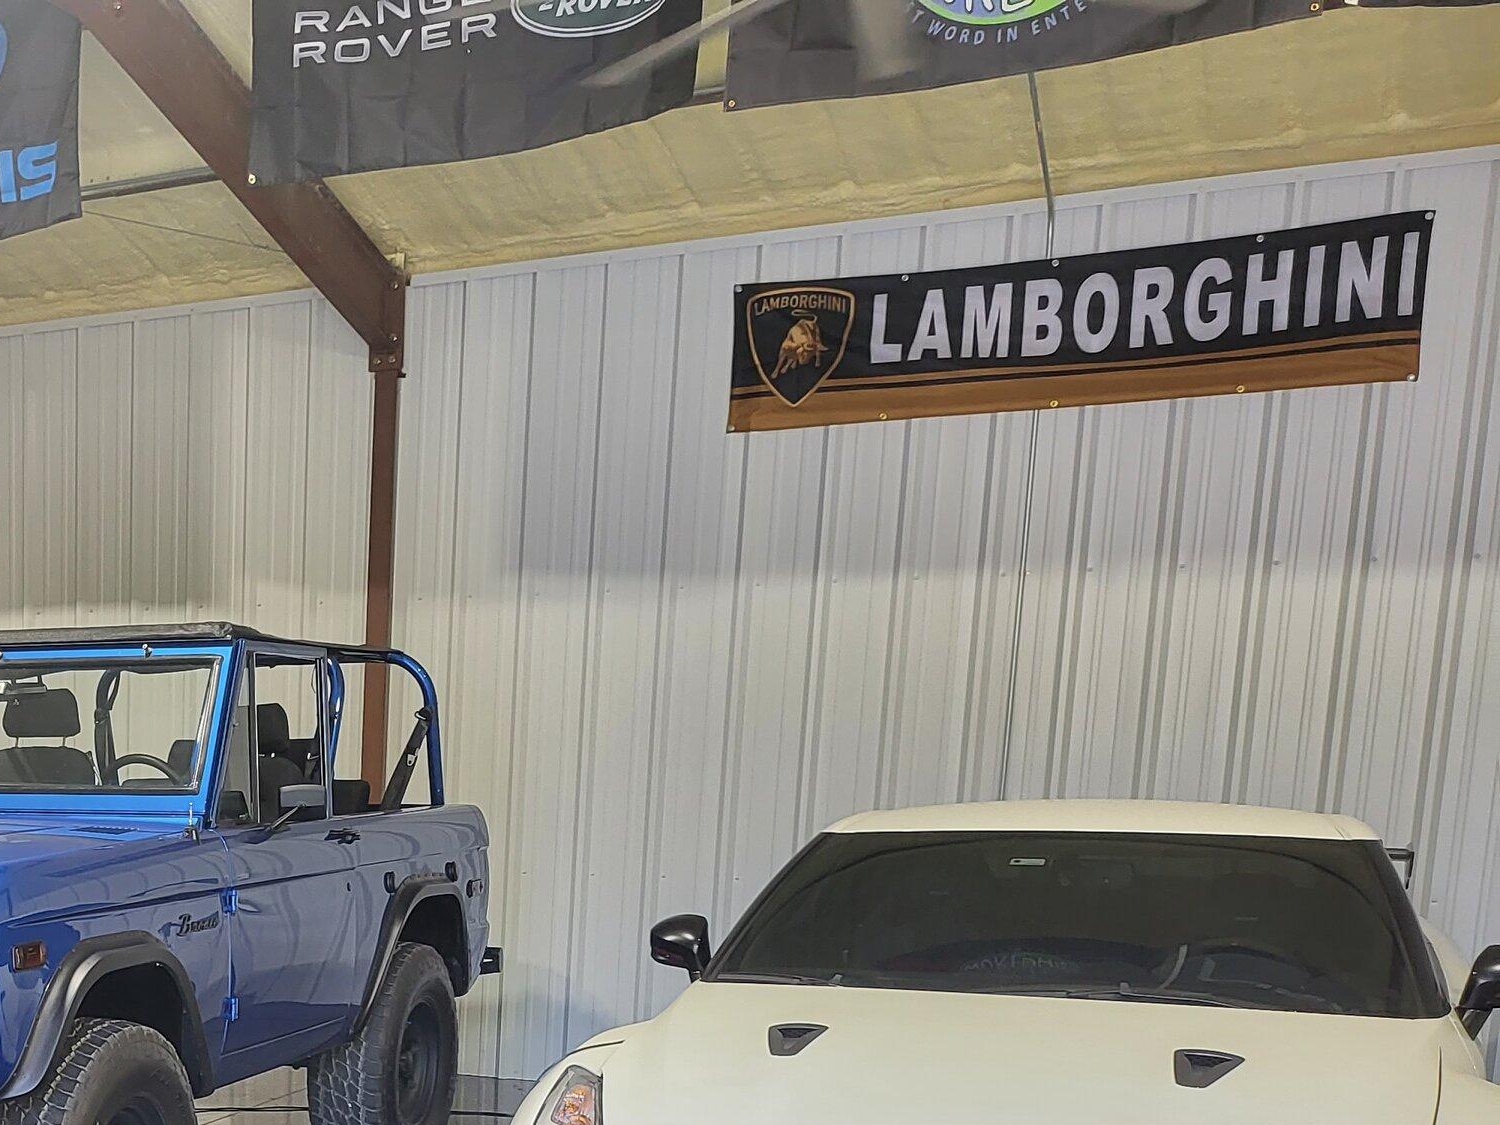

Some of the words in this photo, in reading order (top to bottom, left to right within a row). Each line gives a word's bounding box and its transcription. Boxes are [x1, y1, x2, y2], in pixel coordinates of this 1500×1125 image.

[293, 0, 492, 34] RANG
[926, 18, 986, 46] WORD
[996, 25, 1019, 43] IN
[292, 13, 498, 68] ROVER
[753, 294, 848, 316] LAMBORGHINI
[869, 231, 1420, 365] LAMBORGHINI
